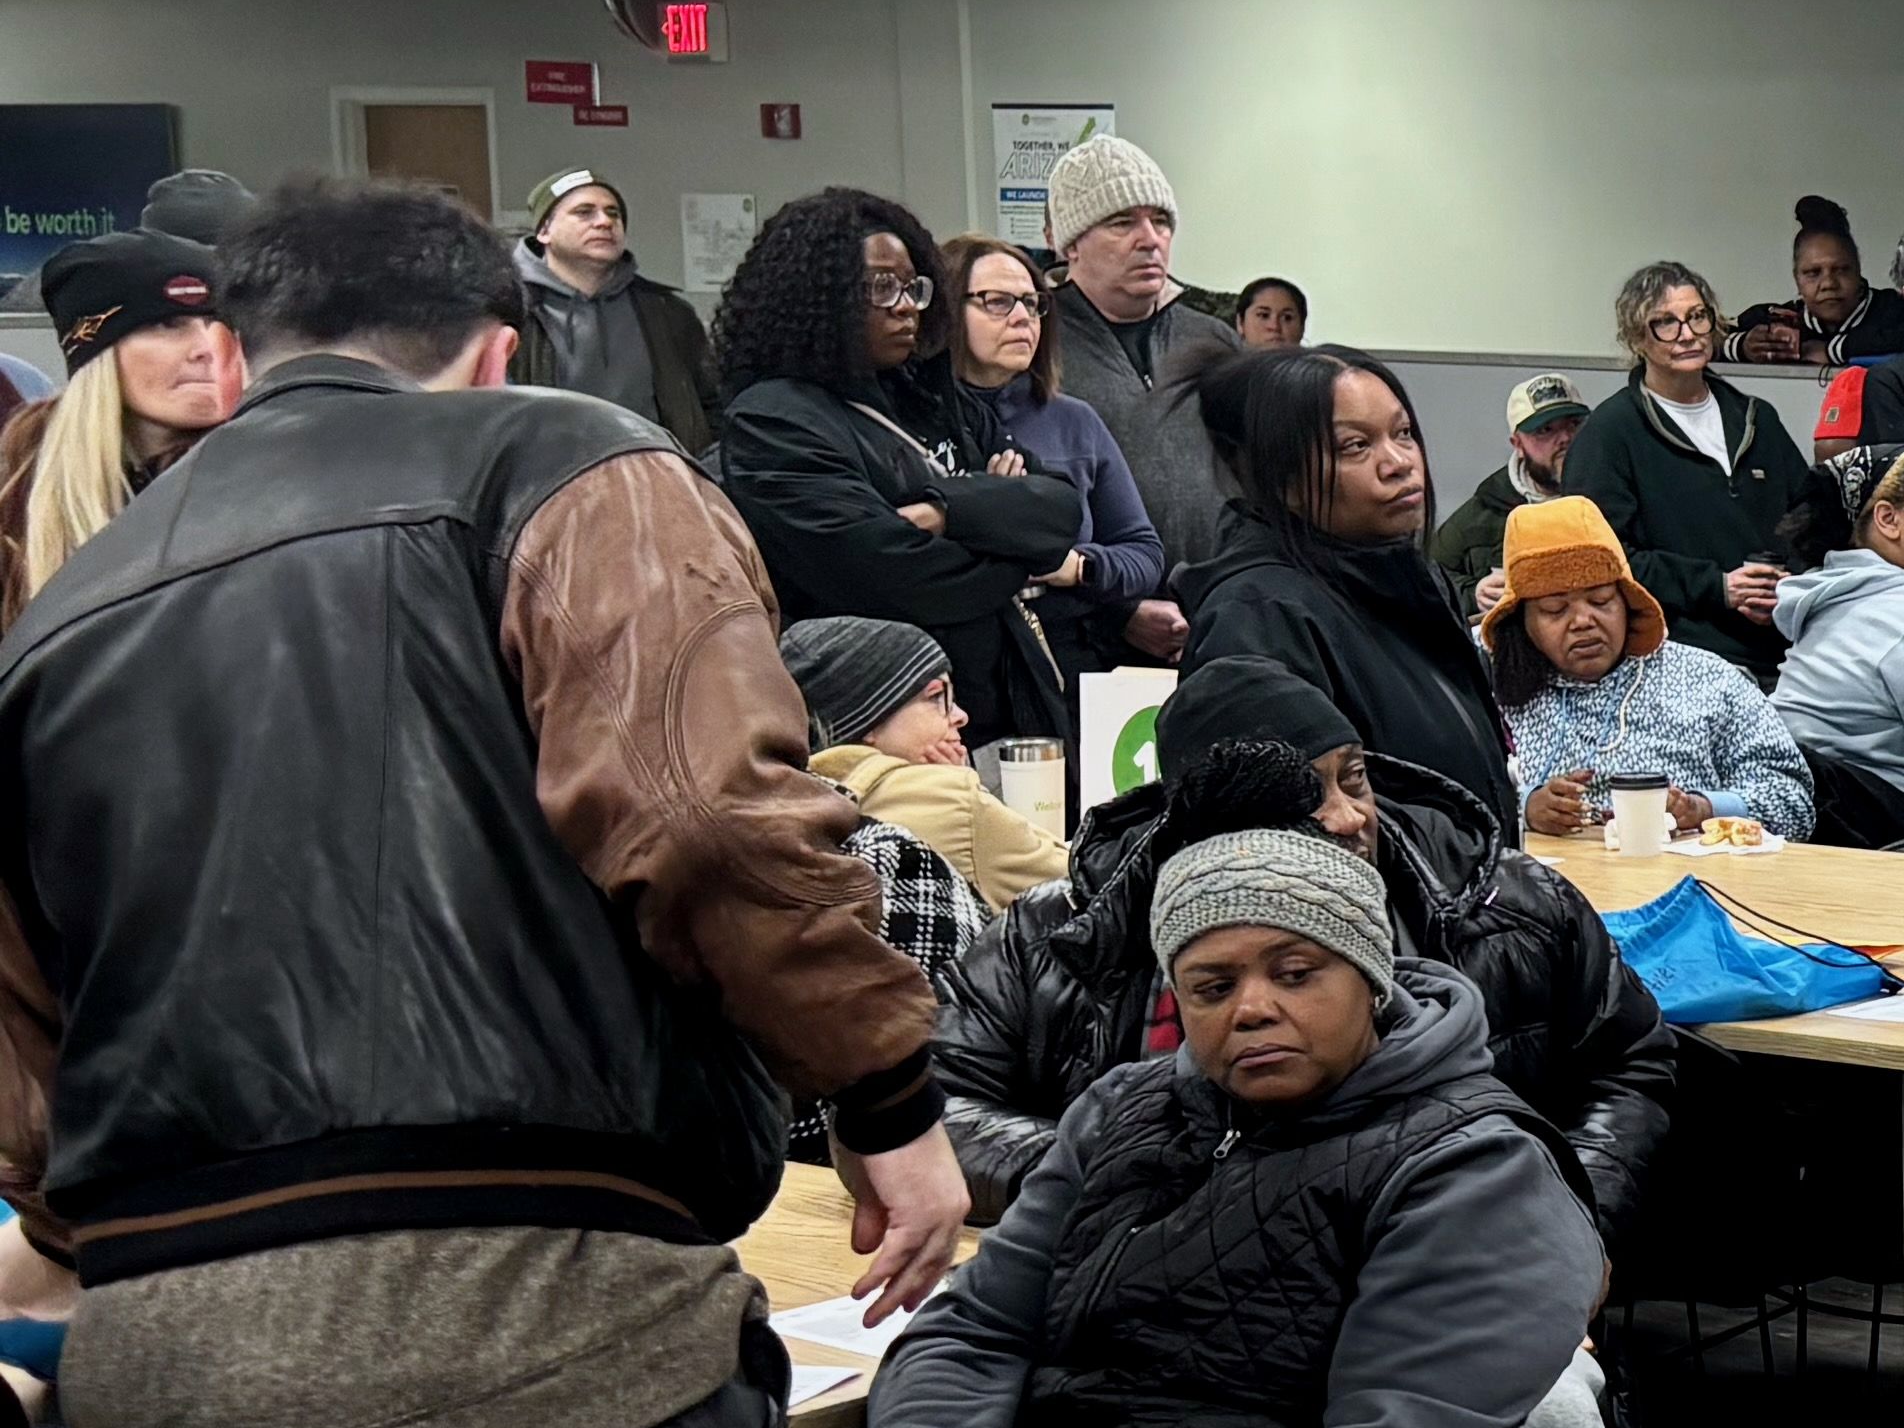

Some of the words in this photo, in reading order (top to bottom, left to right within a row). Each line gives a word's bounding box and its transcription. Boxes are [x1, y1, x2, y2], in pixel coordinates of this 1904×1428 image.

[666, 4, 708, 52] EXIT
[1000, 152, 1058, 180] ARIZ
[5, 205, 31, 235] be
[35, 208, 96, 236] worth
[101, 207, 115, 235] it
